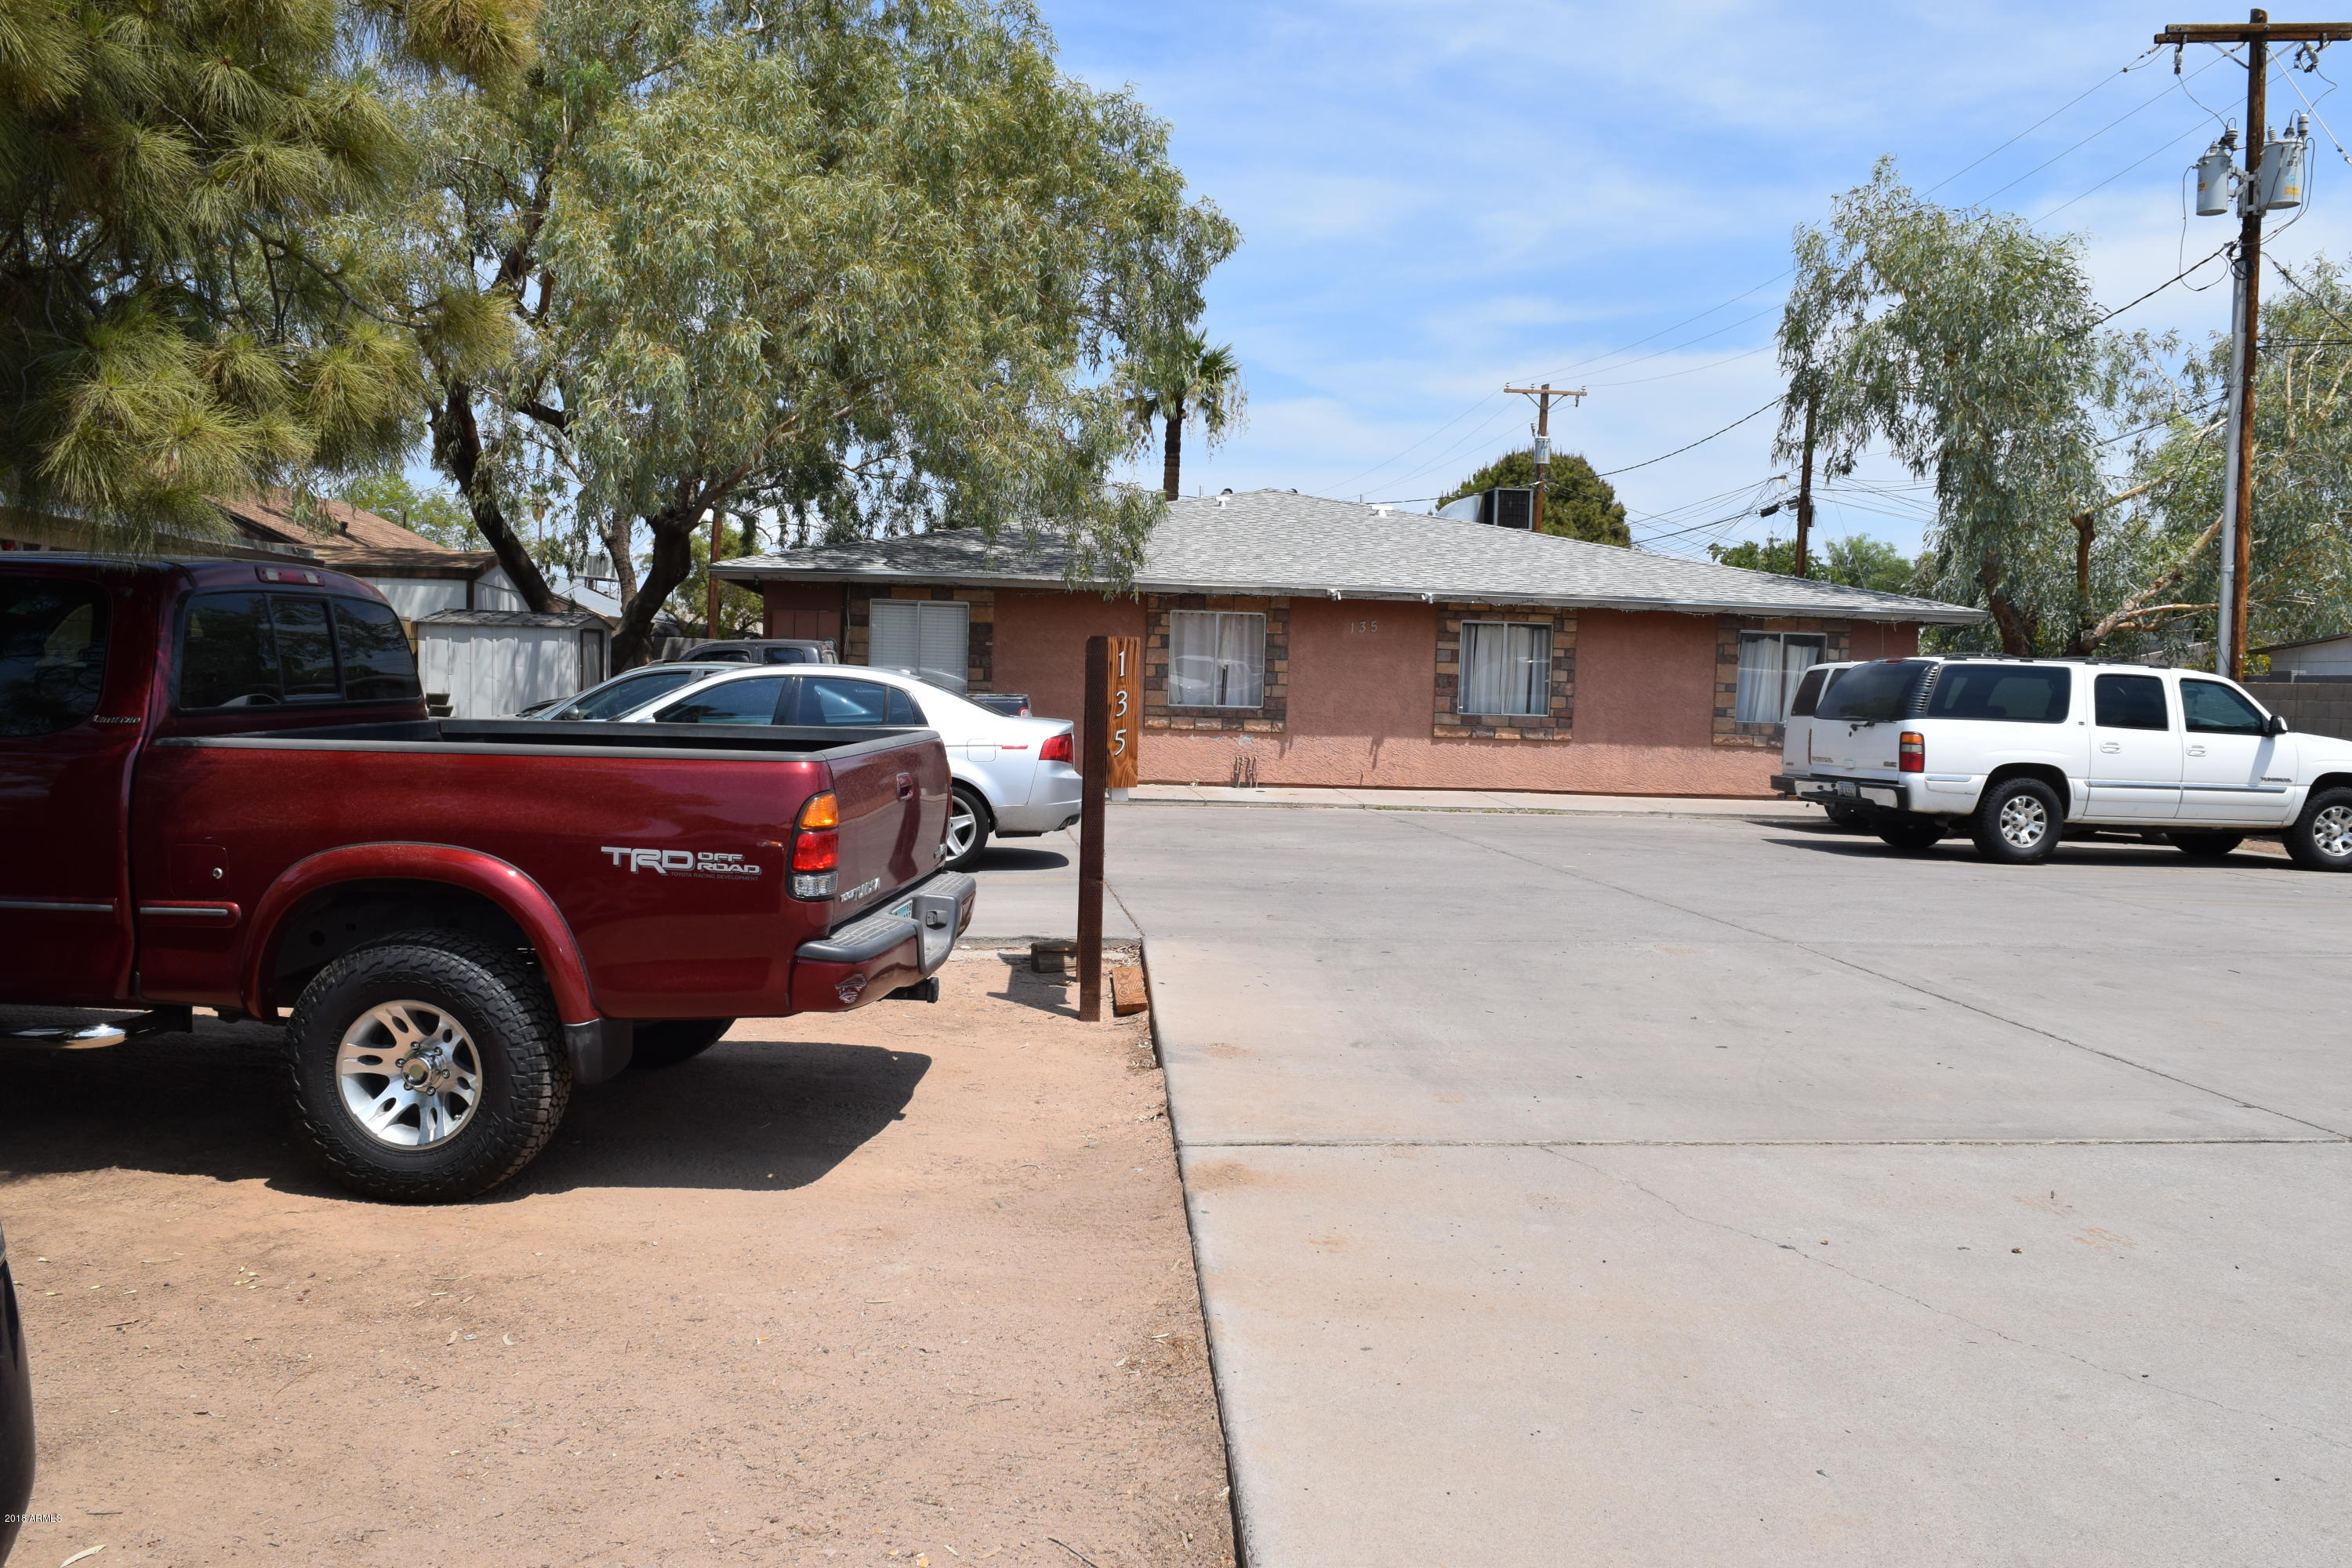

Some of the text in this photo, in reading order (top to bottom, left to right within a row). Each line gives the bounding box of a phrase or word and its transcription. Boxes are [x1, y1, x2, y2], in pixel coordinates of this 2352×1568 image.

[1350, 620, 1377, 633] 135
[1114, 650, 1128, 757] 135
[601, 846, 695, 875] TRD
[697, 851, 745, 862] OFF
[697, 862, 762, 875] ROAD
